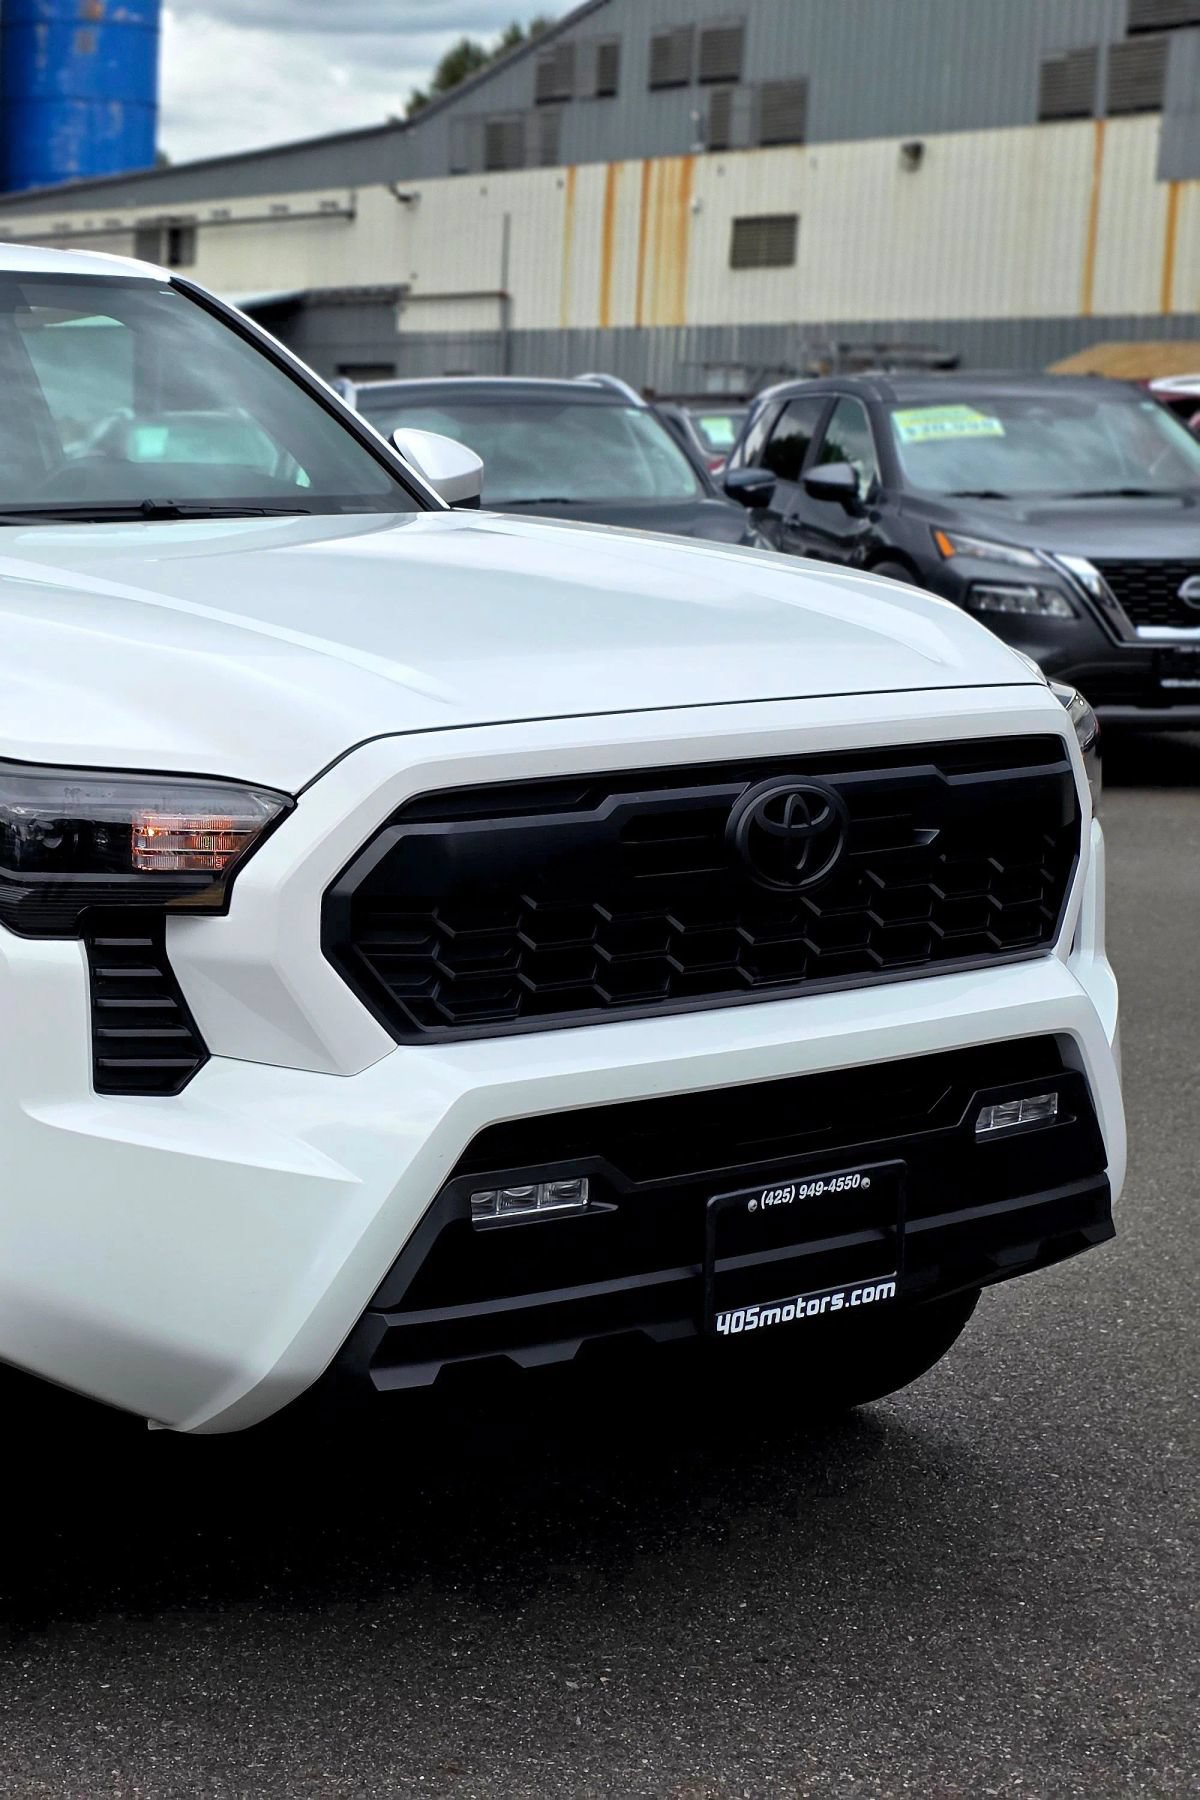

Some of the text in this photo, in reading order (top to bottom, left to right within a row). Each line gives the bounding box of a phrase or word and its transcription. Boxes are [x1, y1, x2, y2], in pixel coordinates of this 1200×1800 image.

[760, 1174, 861, 1210] (425) 949-4550
[715, 1281, 896, 1335] 405motors.com
